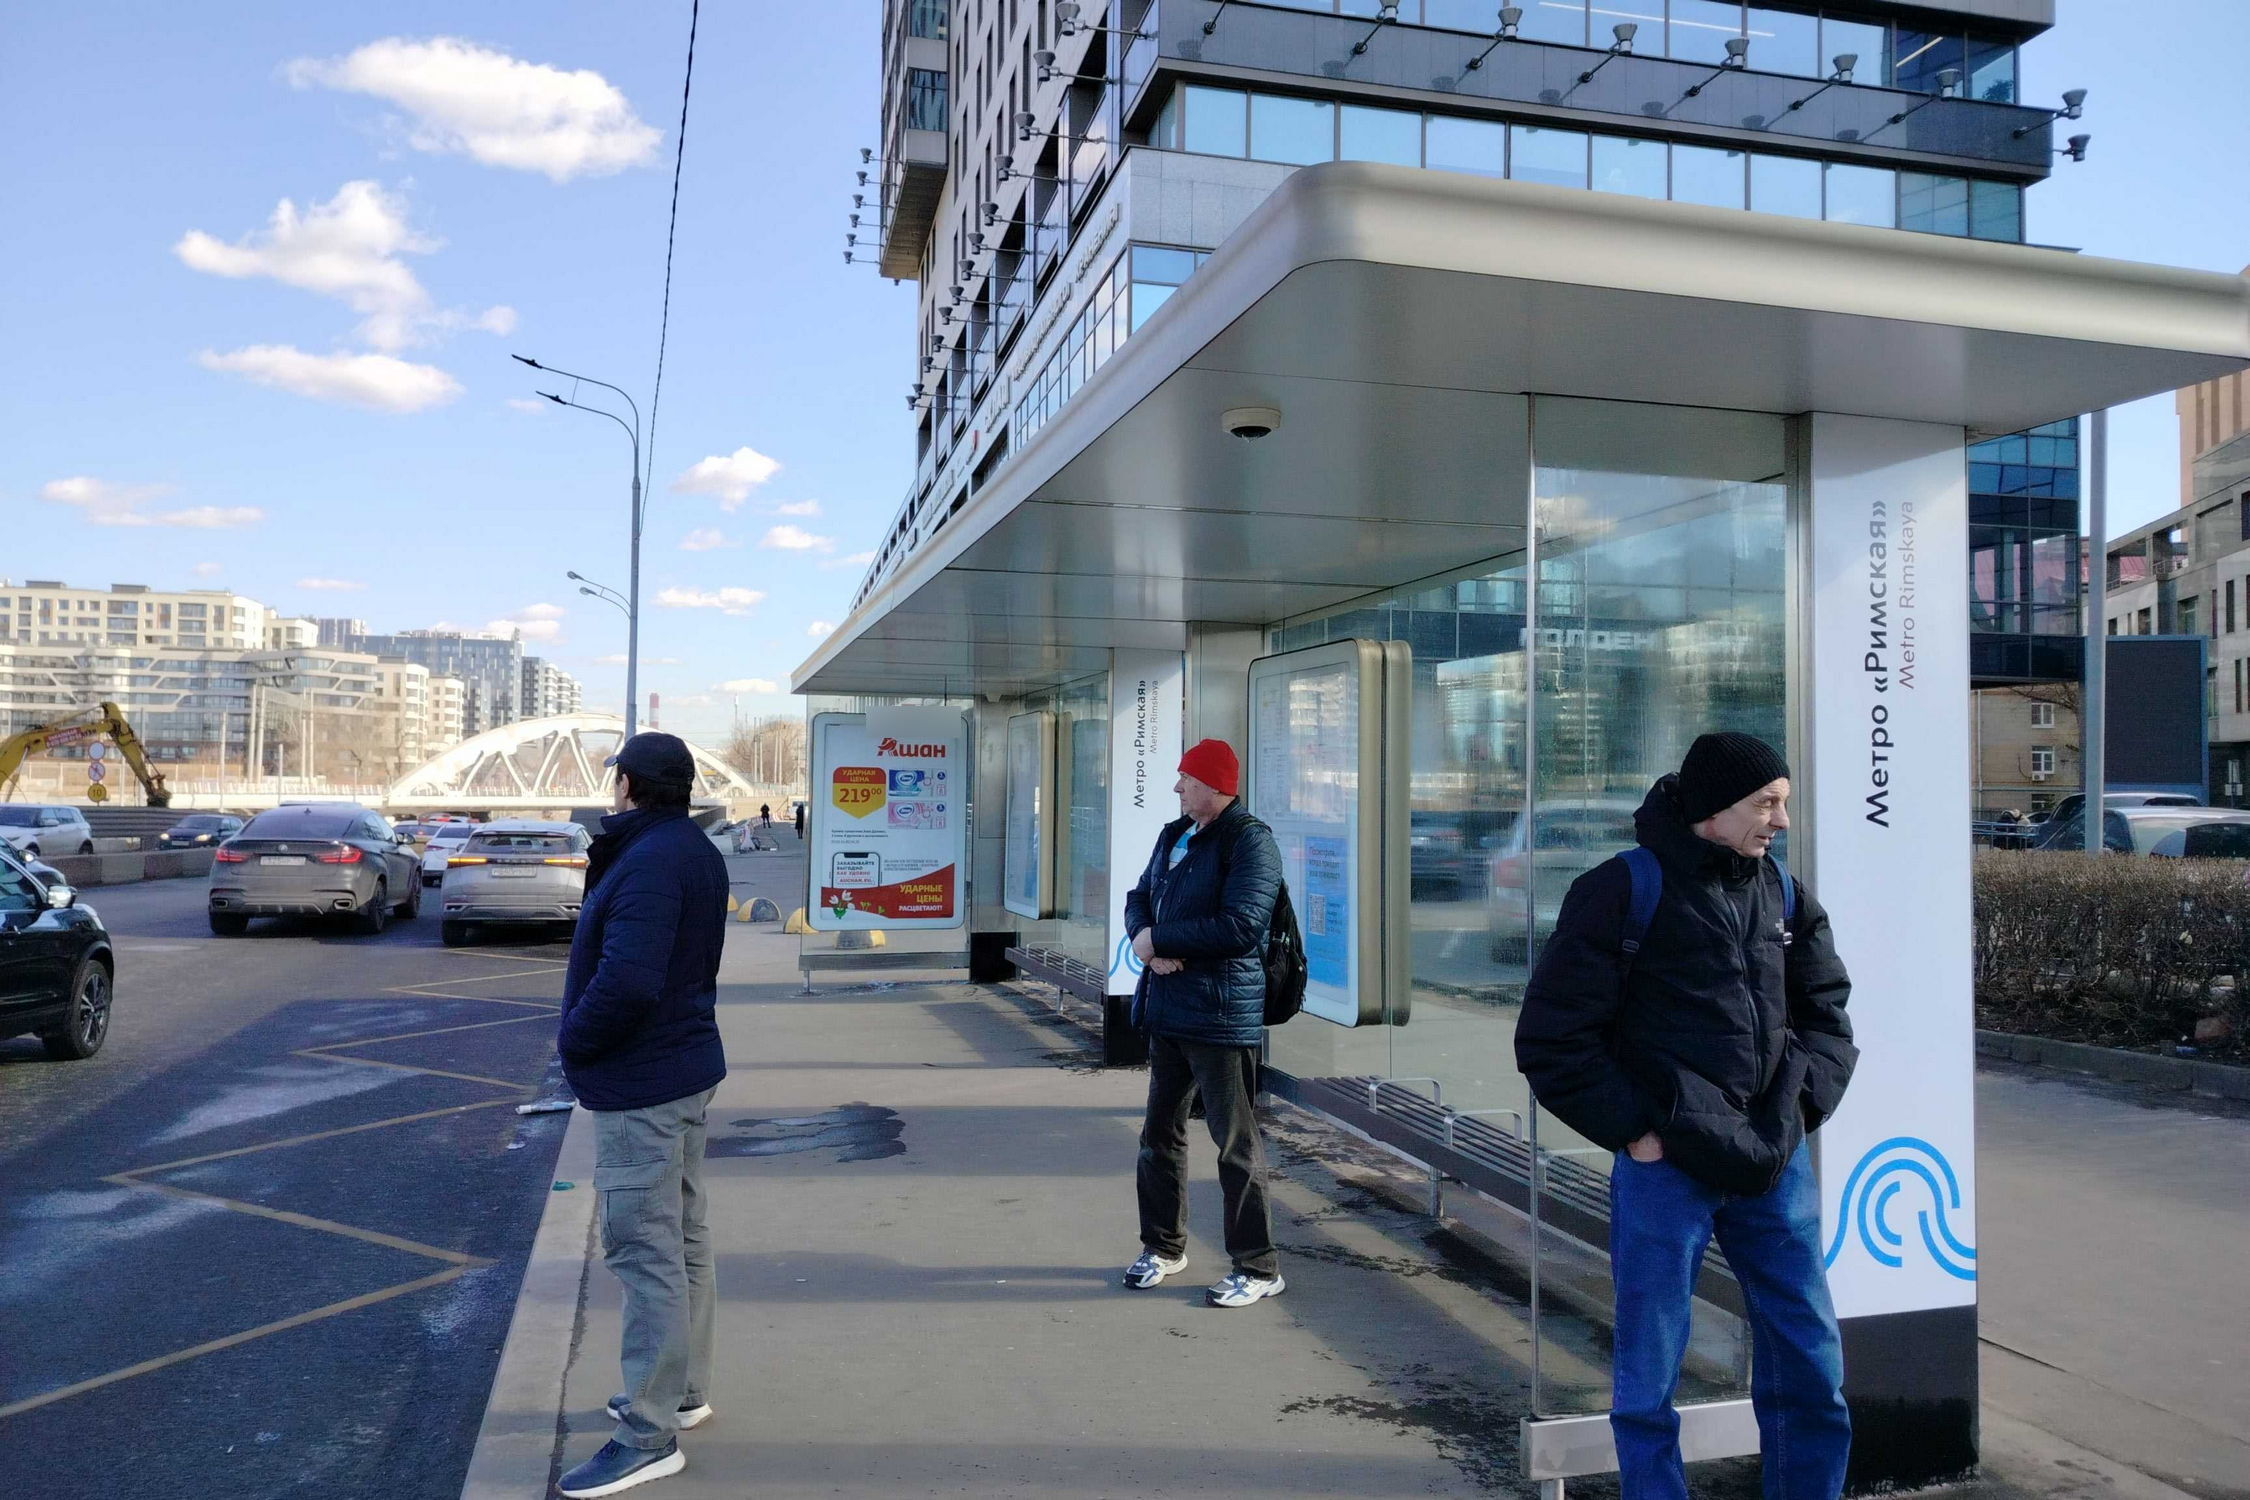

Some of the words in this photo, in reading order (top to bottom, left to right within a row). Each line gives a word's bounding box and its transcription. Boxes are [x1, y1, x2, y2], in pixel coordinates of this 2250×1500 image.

[1897, 502, 1917, 608] Rimskaya
[1864, 500, 1889, 693] «Римская»
[1899, 618, 1915, 689] Metro
[1134, 680, 1146, 756] «Римская»
[1150, 680, 1159, 722] Rimskaya
[1150, 726, 1158, 754] Metro
[842, 769, 876, 777] УДАРНАЯ
[1134, 760, 1146, 808] Метро
[1866, 705, 1893, 828] Метро
[93, 789, 102, 797] 10
[839, 788, 871, 803] 219
[900, 885, 943, 893] УДАРНЫЕ
[917, 894, 943, 903] ЦЕНЫ
